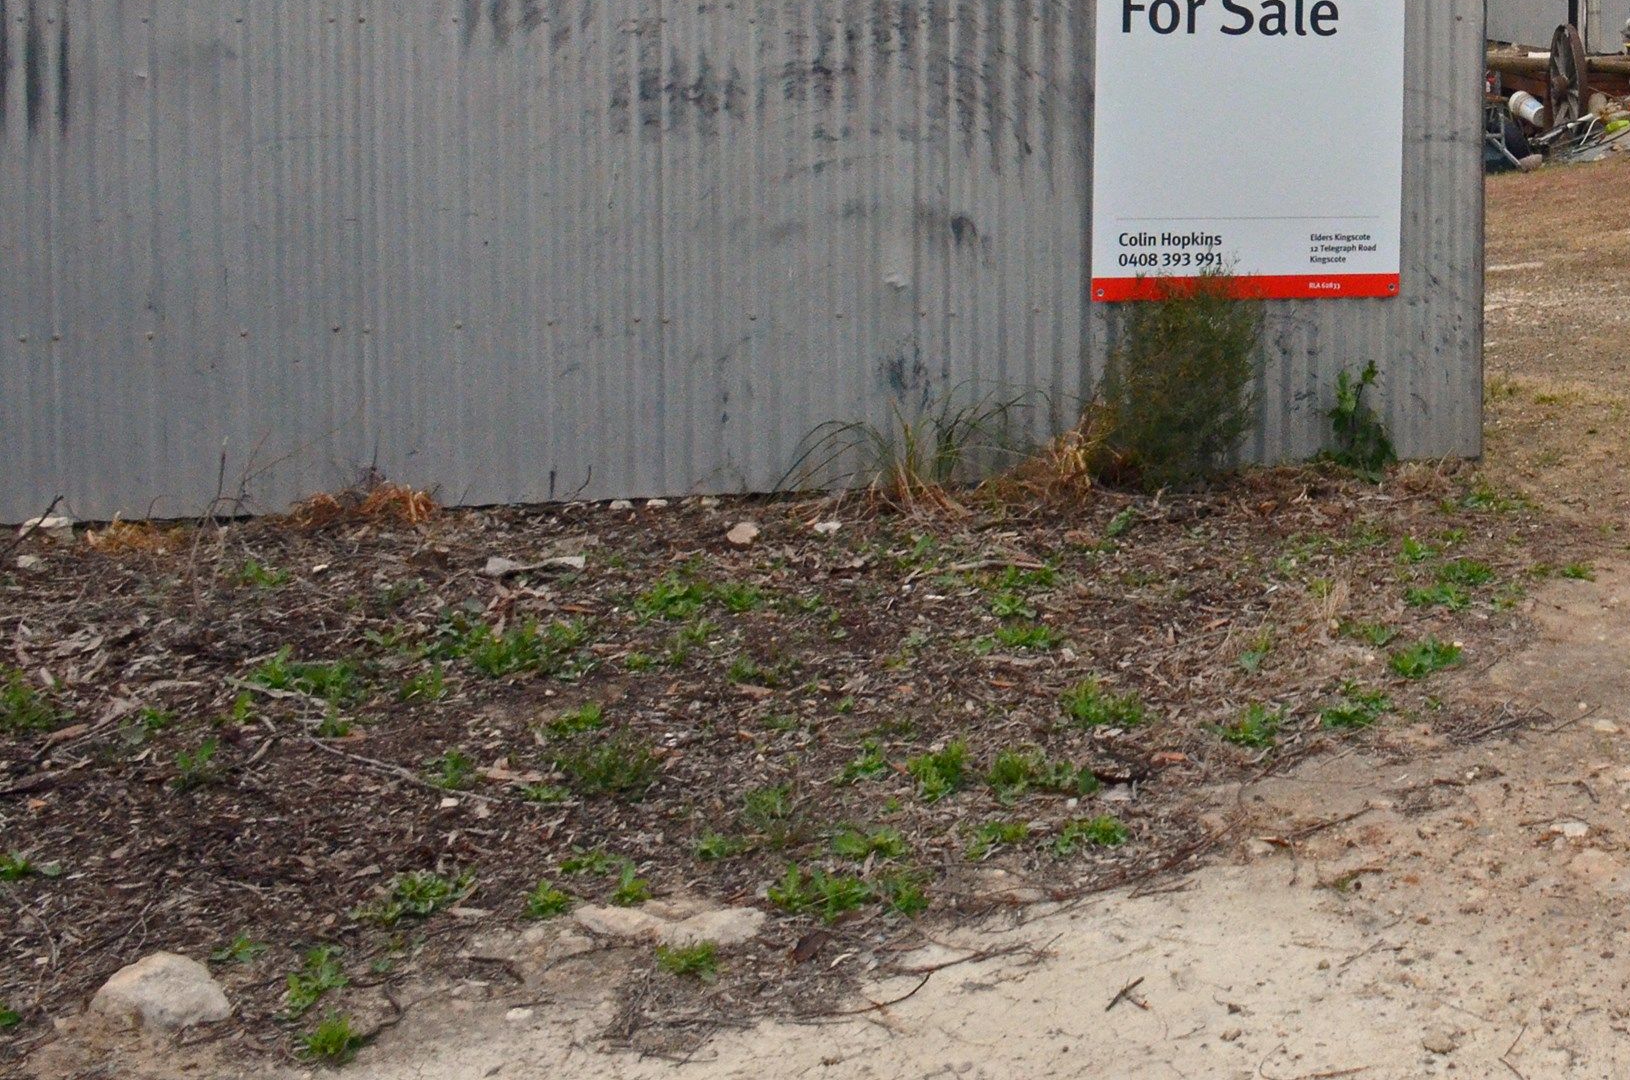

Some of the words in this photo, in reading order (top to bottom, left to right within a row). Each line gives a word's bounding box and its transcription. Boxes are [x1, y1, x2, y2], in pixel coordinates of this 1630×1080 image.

[1118, 232, 1157, 247] Colin
[1161, 232, 1223, 250] Hopkins
[1310, 233, 1333, 242] Elders
[1334, 233, 1371, 243] Kingscote
[1320, 244, 1357, 254] Telegraph
[1358, 243, 1377, 252] Road
[1118, 253, 1158, 267] 0408
[1161, 252, 1191, 267] 393
[1195, 252, 1223, 267] 991
[1309, 255, 1347, 265] Kingscote
